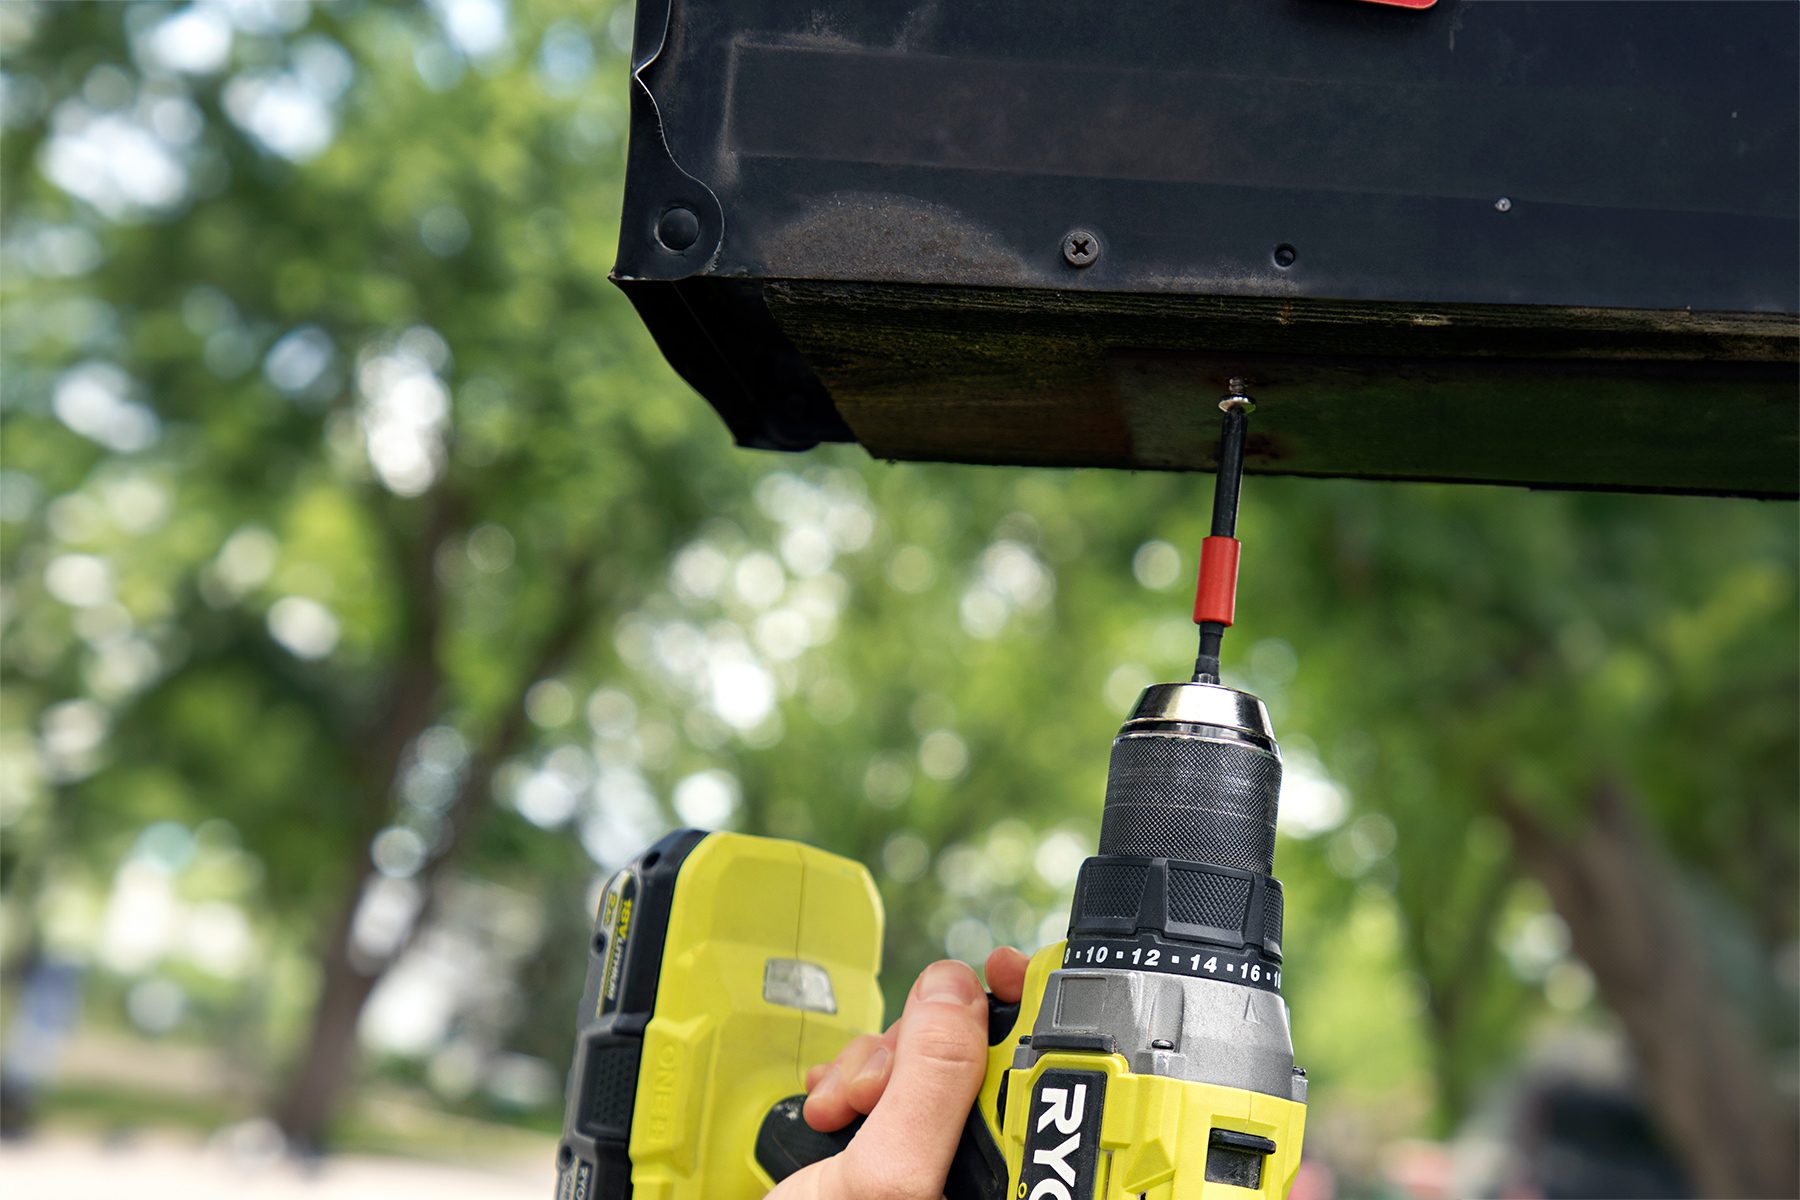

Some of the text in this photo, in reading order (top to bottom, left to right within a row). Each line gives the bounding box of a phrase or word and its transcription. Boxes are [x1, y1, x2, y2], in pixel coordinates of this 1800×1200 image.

[619, 898, 633, 940] 18V
[1086, 946, 1109, 963] 10
[1131, 948, 1161, 967] 12
[1190, 954, 1217, 973] 14
[1240, 962, 1261, 982] 16
